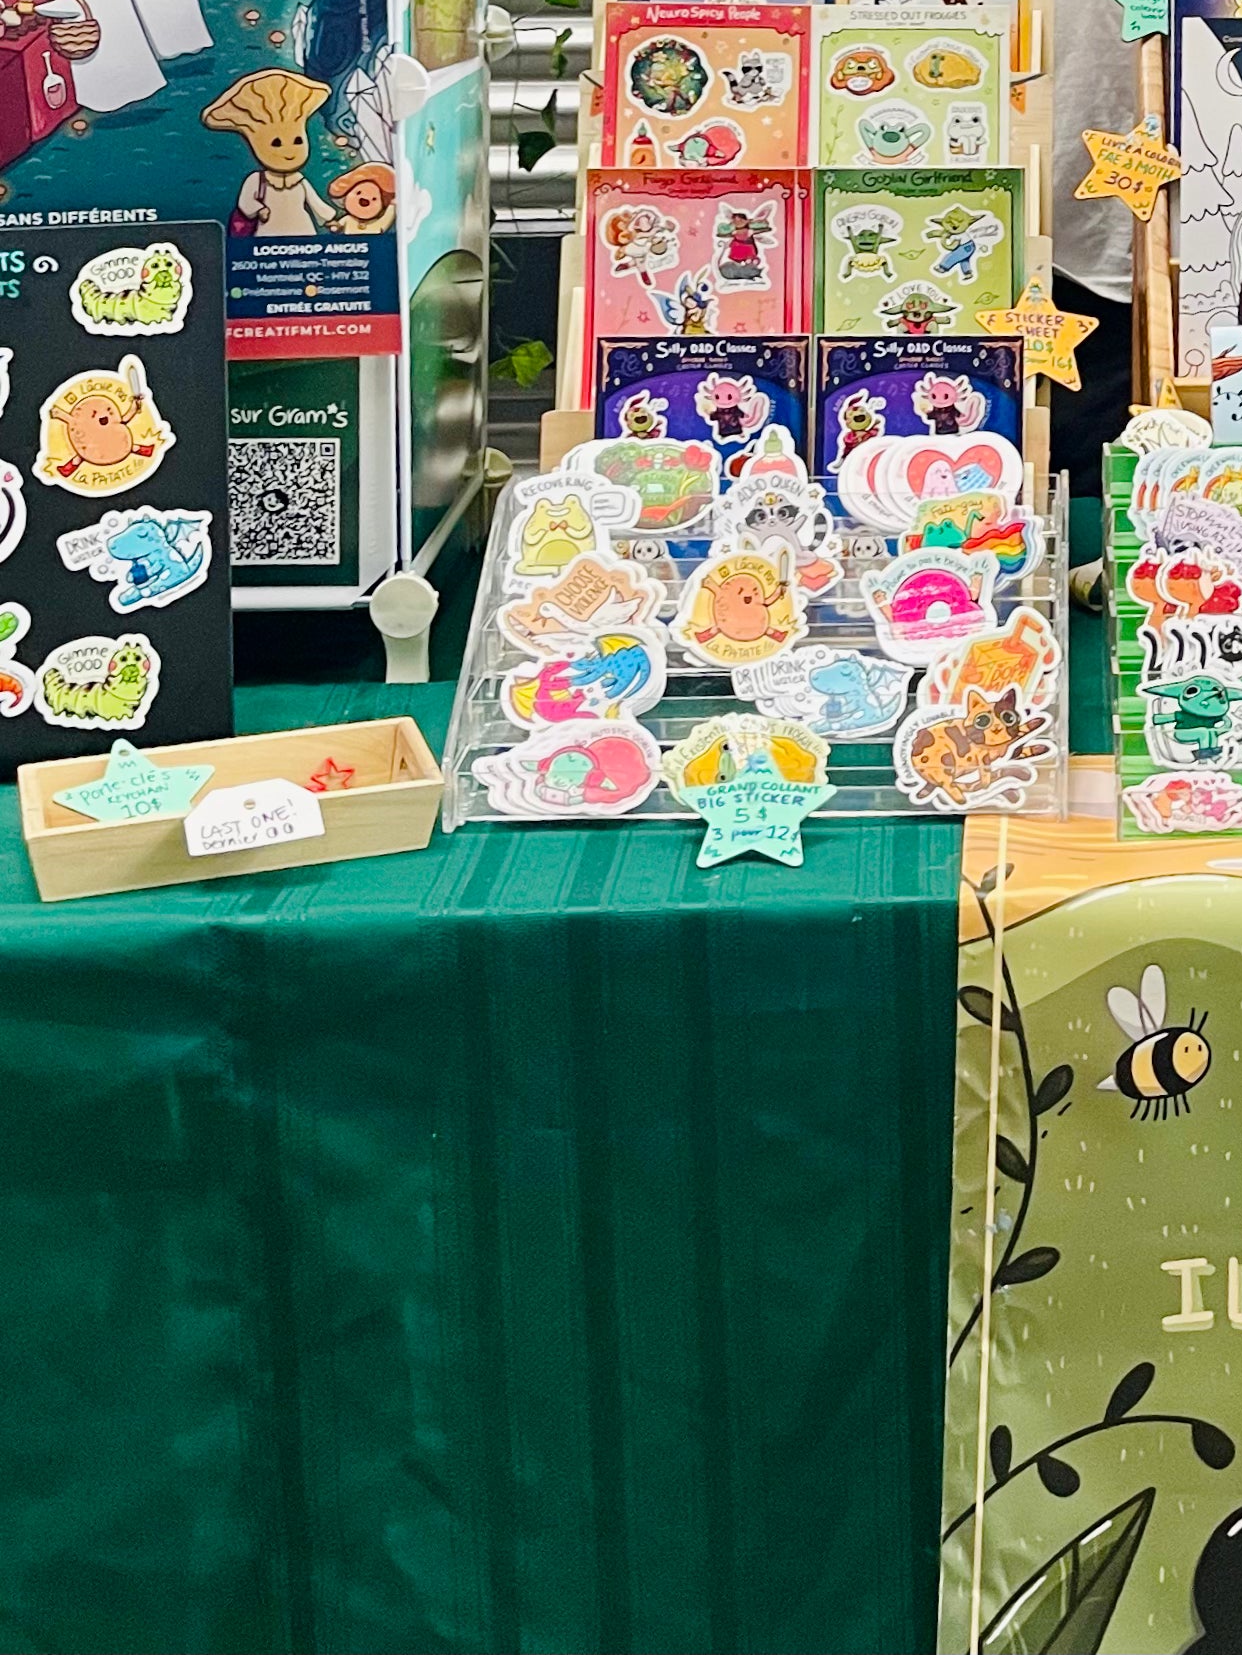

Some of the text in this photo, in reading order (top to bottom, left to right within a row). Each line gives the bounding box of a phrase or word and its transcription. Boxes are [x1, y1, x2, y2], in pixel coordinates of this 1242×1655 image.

[850, 9, 897, 22] STRESSED
[900, 9, 921, 21] OUT
[1098, 148, 1174, 180] FAE MOTH
[910, 171, 972, 186] Girlfriend
[48, 207, 158, 225] DIFFÉRENTS
[253, 242, 369, 256] LOCOSHOP ANGUS
[90, 255, 140, 276] Gimme
[100, 267, 135, 285] FOOD
[306, 271, 324, 282] QC
[898, 284, 922, 301] LOVE
[266, 300, 371, 314] ENTRÉE GRATUITE
[1005, 312, 1065, 327] STICKER
[1016, 323, 1059, 338] SHEET
[716, 340, 757, 357] Classes
[932, 340, 972, 357] Classes
[231, 406, 259, 425] sur
[521, 476, 593, 497] RECOVERING
[771, 474, 806, 496] QUEEN
[65, 532, 102, 557] DRINK
[555, 565, 598, 606] CHOOSE
[569, 578, 609, 616] VIOLENCE
[58, 646, 109, 665] Gimme
[68, 658, 102, 676] FOOD
[772, 660, 807, 676] DRINK
[707, 782, 822, 796] GRAND COLLANT
[697, 793, 805, 809] BIG STICKER
[200, 820, 242, 840] LAST
[712, 828, 723, 841] 3
